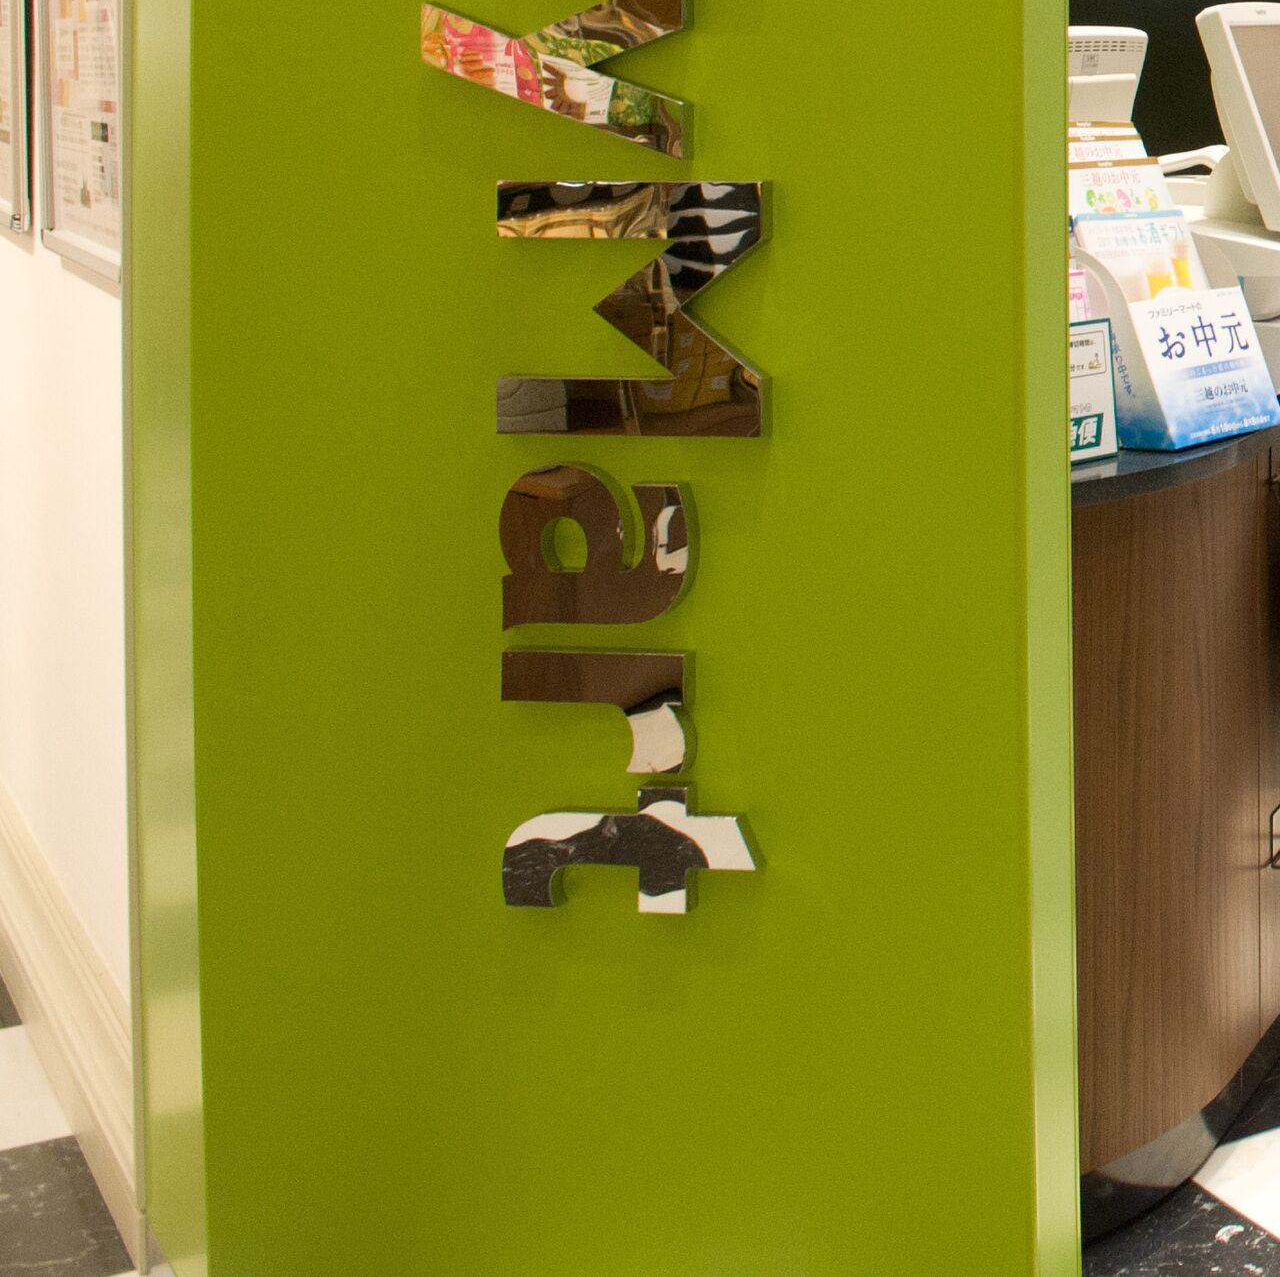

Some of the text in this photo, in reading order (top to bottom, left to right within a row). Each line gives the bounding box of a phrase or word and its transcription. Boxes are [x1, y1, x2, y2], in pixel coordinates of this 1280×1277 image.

[1158, 312, 1250, 360] お中元
[1195, 378, 1249, 402] 三越のお中元
